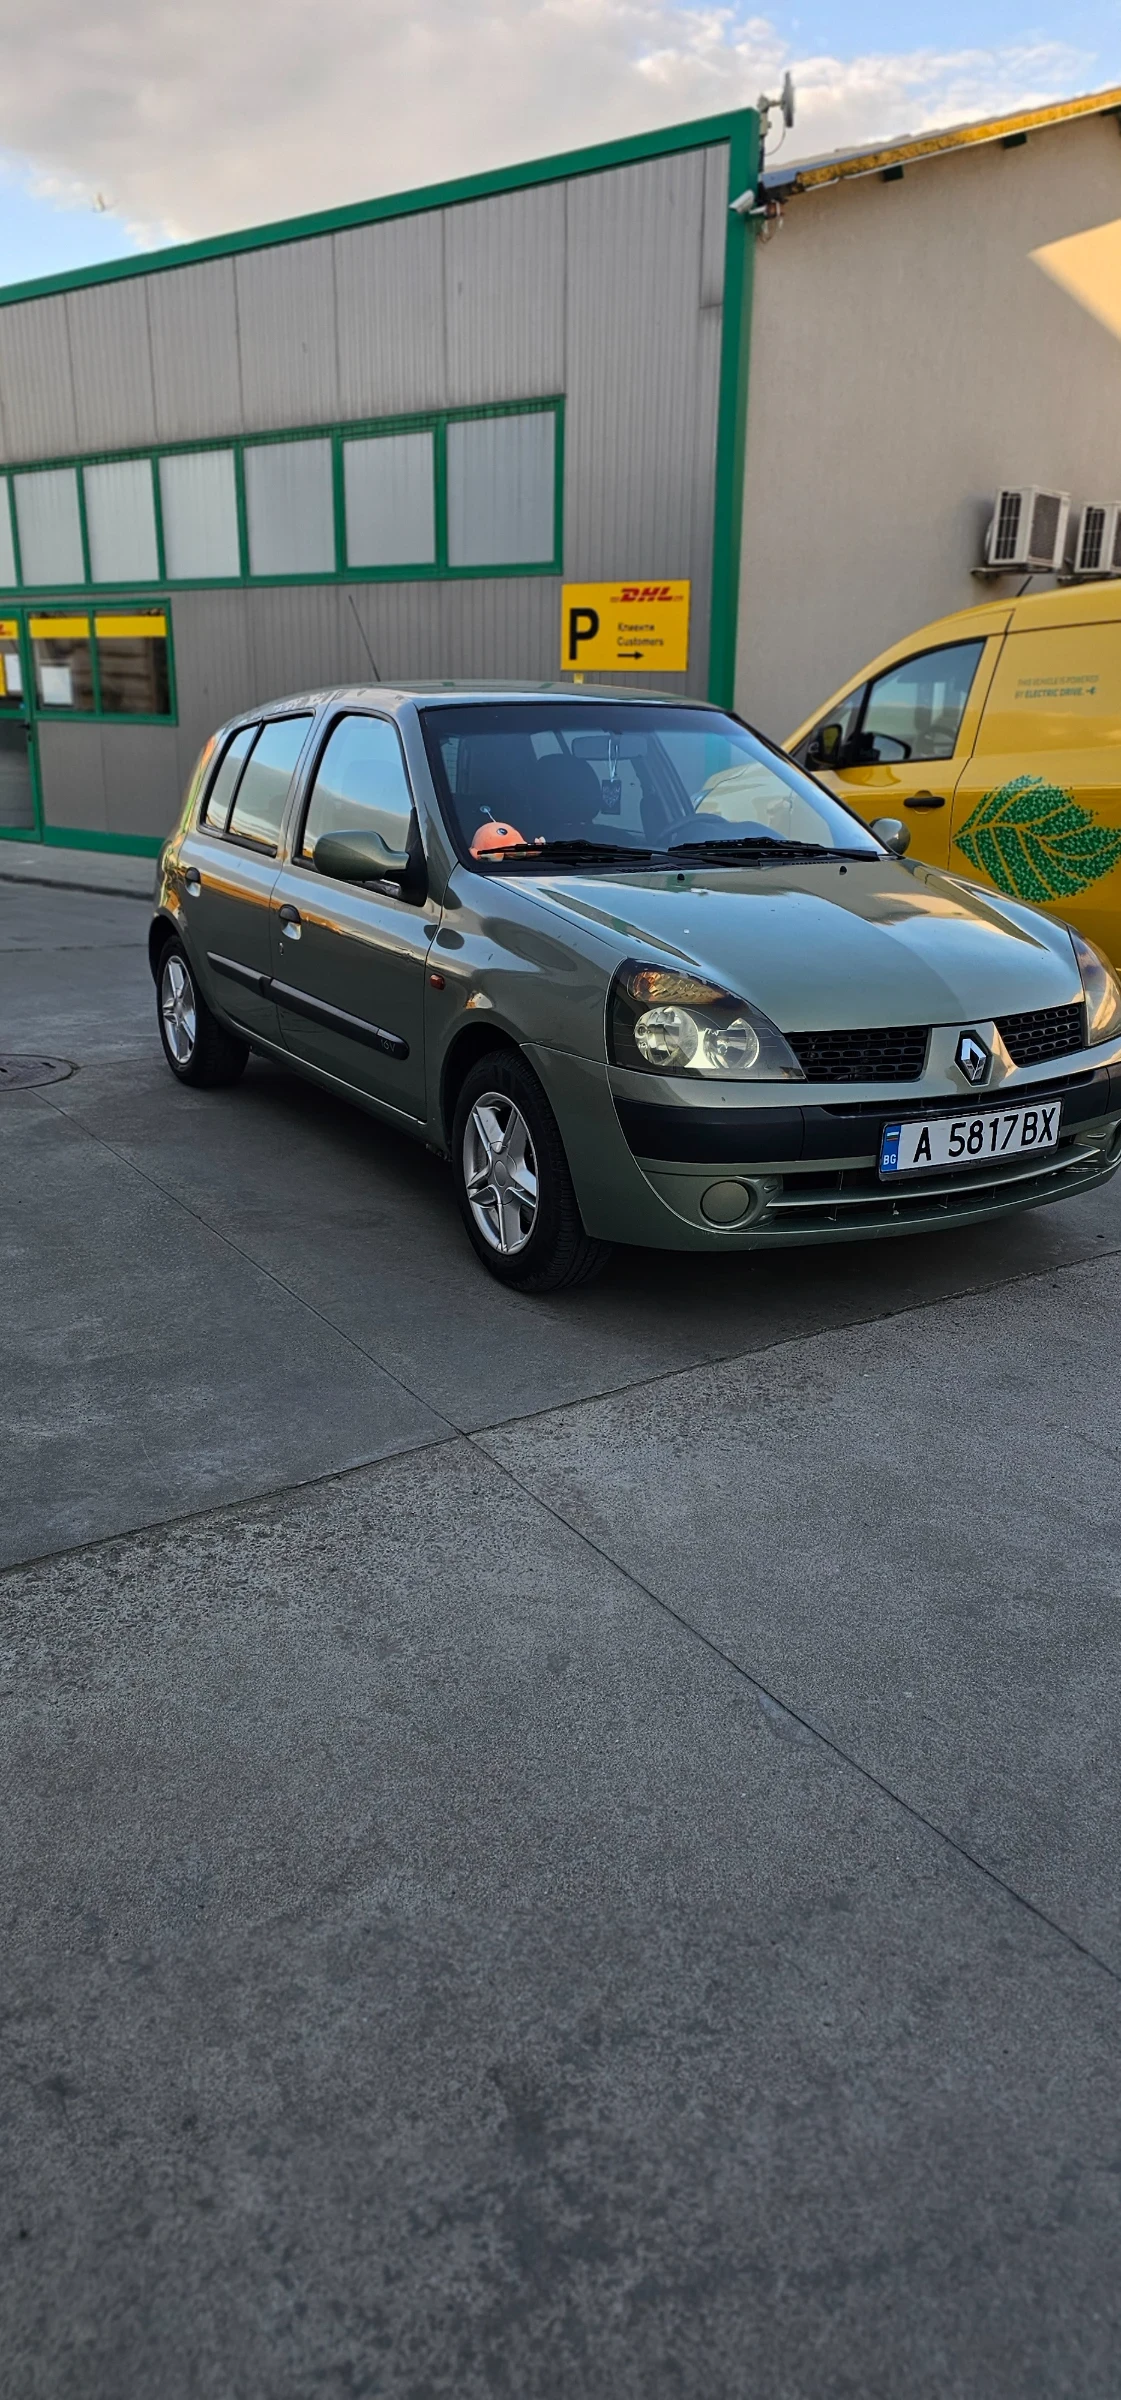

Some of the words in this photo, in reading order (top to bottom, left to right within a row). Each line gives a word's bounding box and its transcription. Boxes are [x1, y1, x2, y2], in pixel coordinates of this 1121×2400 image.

[619, 586, 674, 603] DHL
[569, 608, 599, 660] P
[617, 636, 664, 647] Customers
[1025, 688, 1058, 699] ELECTRIC
[913, 1126, 932, 1163] A
[883, 1154, 897, 1166] BG
